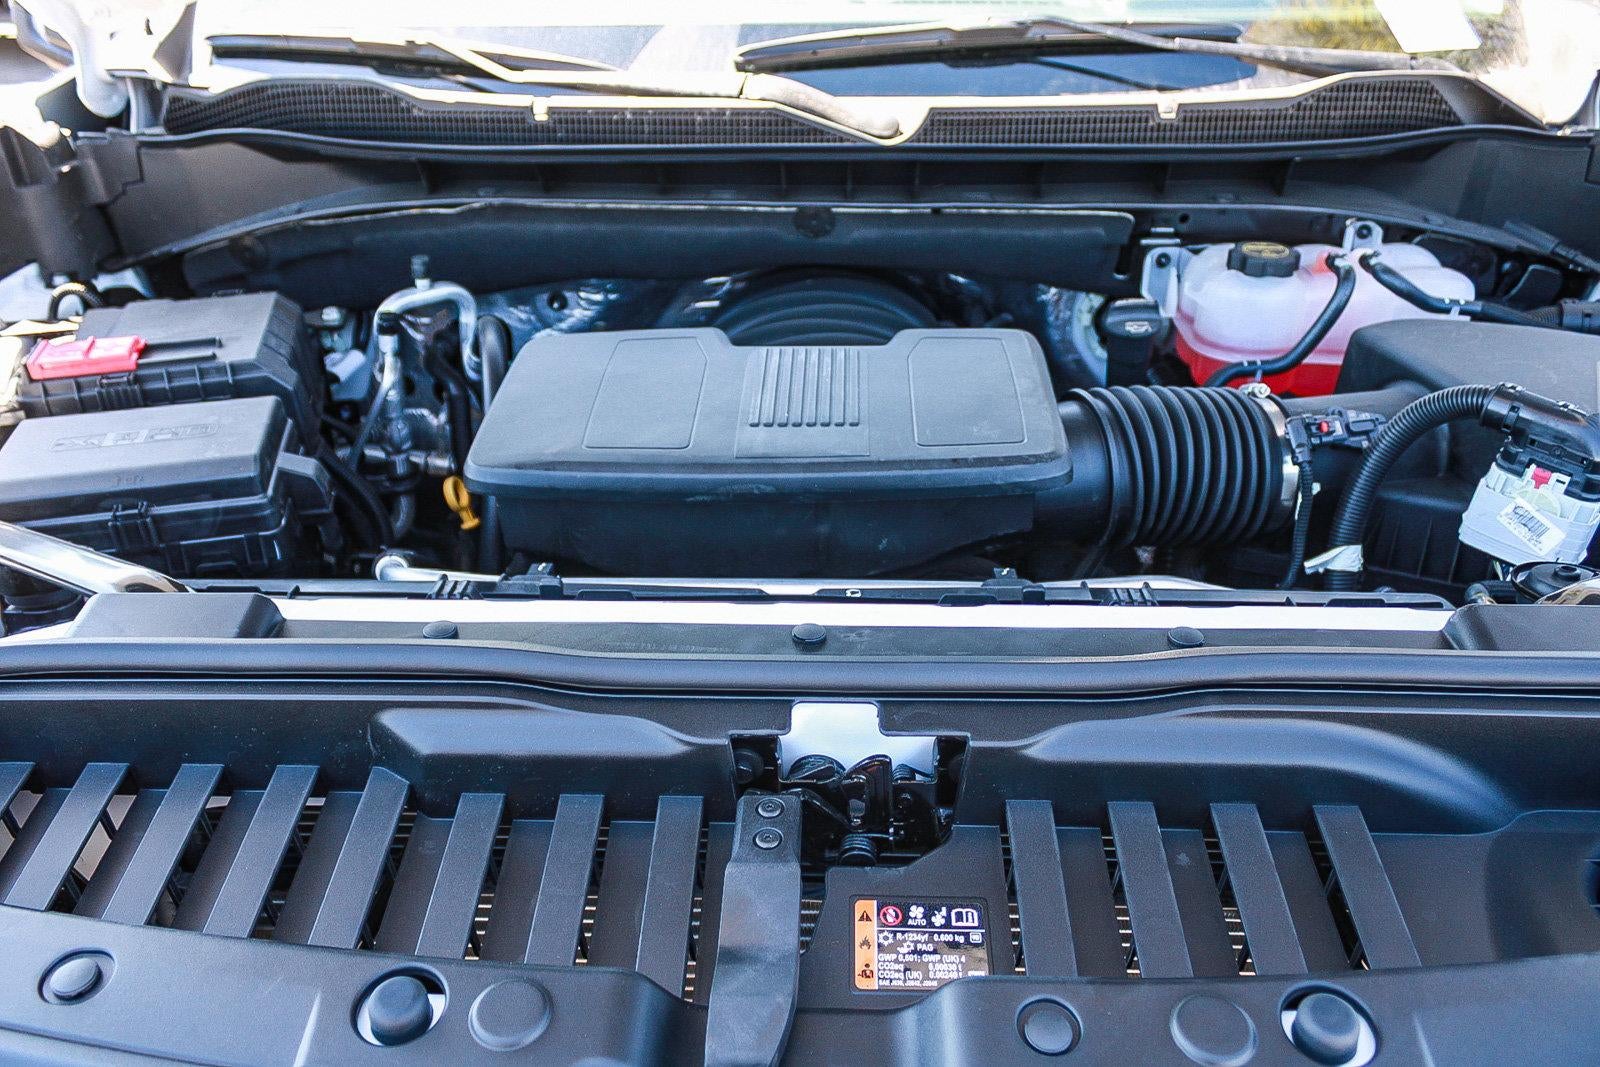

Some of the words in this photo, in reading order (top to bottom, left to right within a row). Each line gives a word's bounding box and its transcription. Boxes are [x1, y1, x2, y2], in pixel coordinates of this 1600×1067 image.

[896, 932, 928, 942] R-1234yf
[955, 934, 964, 943] kg
[942, 955, 959, 963] (UK)
[878, 962, 904, 971] CO2eq
[878, 971, 904, 980] CO2eq
[905, 971, 922, 980] (UK)
